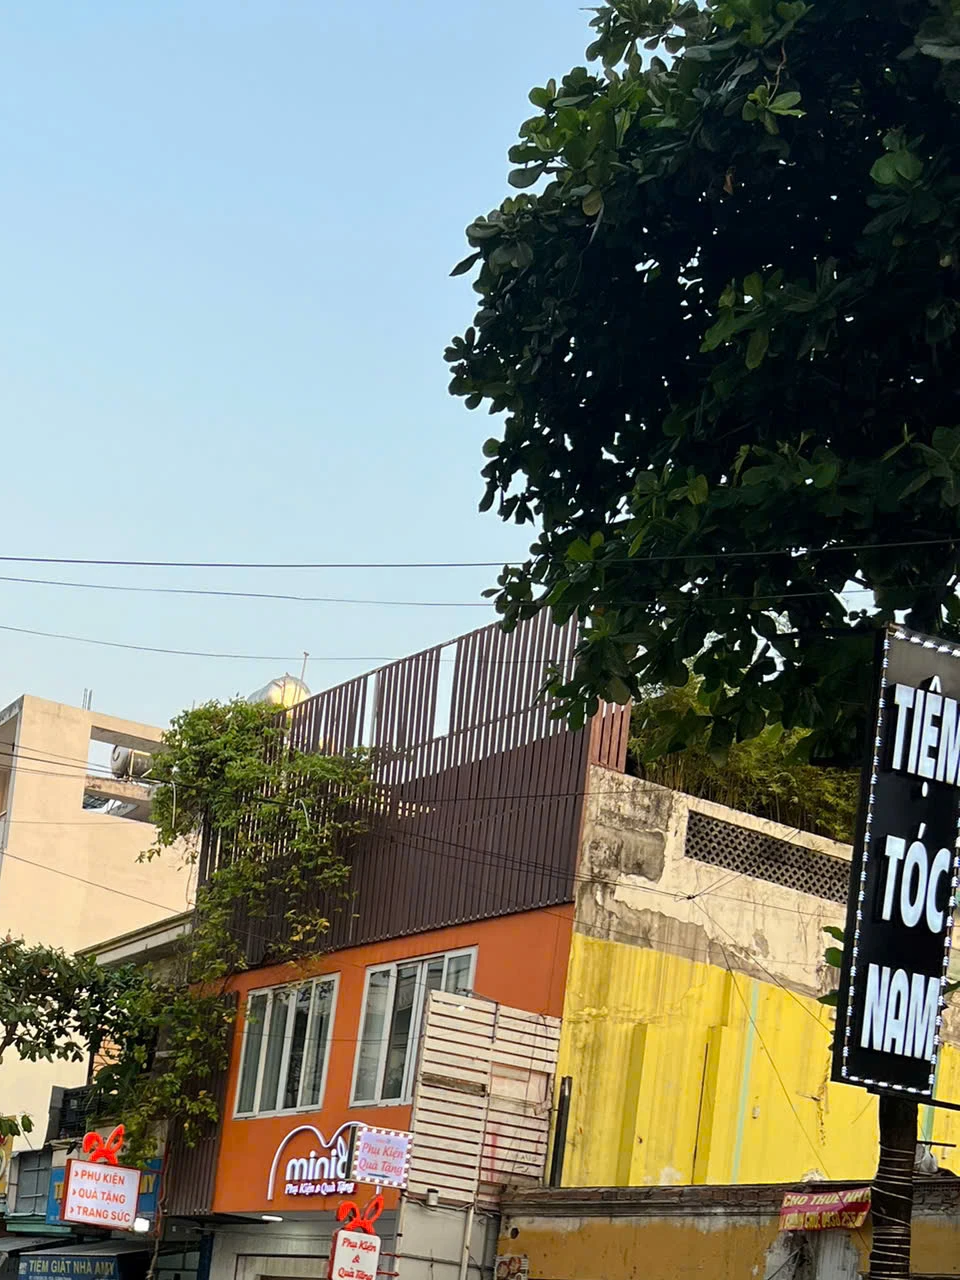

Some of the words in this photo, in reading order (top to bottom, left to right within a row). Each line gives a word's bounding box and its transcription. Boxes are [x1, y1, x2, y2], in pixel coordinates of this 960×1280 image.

[892, 675, 960, 799] TIỆM
[881, 822, 951, 934] TÓC
[860, 962, 940, 1061] NAM
[80, 1169, 100, 1184] PHỤ
[102, 1172, 125, 1188] KIỆN
[78, 1186, 99, 1200] QUÀ
[101, 1189, 126, 1205] TẶNG
[783, 1194, 809, 1207] CHO
[76, 1205, 109, 1220] TRANG
[110, 1207, 131, 1223] SỨC
